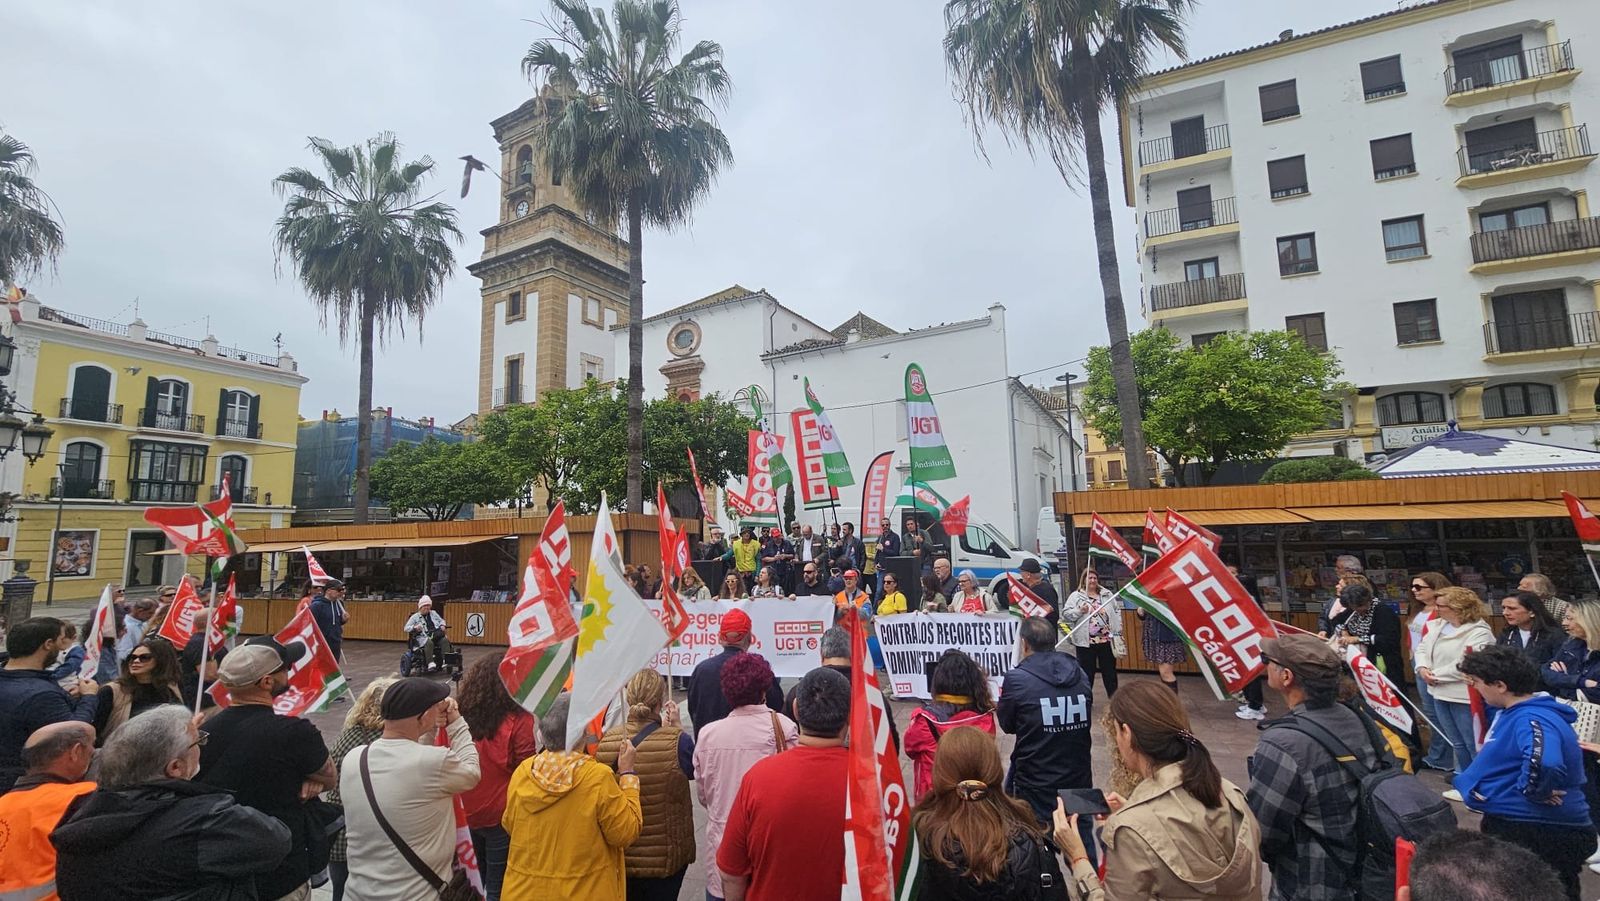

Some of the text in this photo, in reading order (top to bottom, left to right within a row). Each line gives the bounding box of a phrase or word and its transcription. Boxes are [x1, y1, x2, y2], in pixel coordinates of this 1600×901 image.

[1411, 426, 1449, 435] Análisi
[1412, 434, 1438, 443] Clín
[1170, 551, 1262, 671] CCOO
[776, 623, 808, 633] CCOO
[880, 622, 917, 645] CONTRA
[936, 622, 992, 646] RECORTES
[993, 622, 1007, 645] EN
[775, 637, 804, 650] UGT
[649, 650, 700, 669] ganar
[1194, 626, 1242, 684] Cádiz
[1040, 694, 1088, 726] HH
